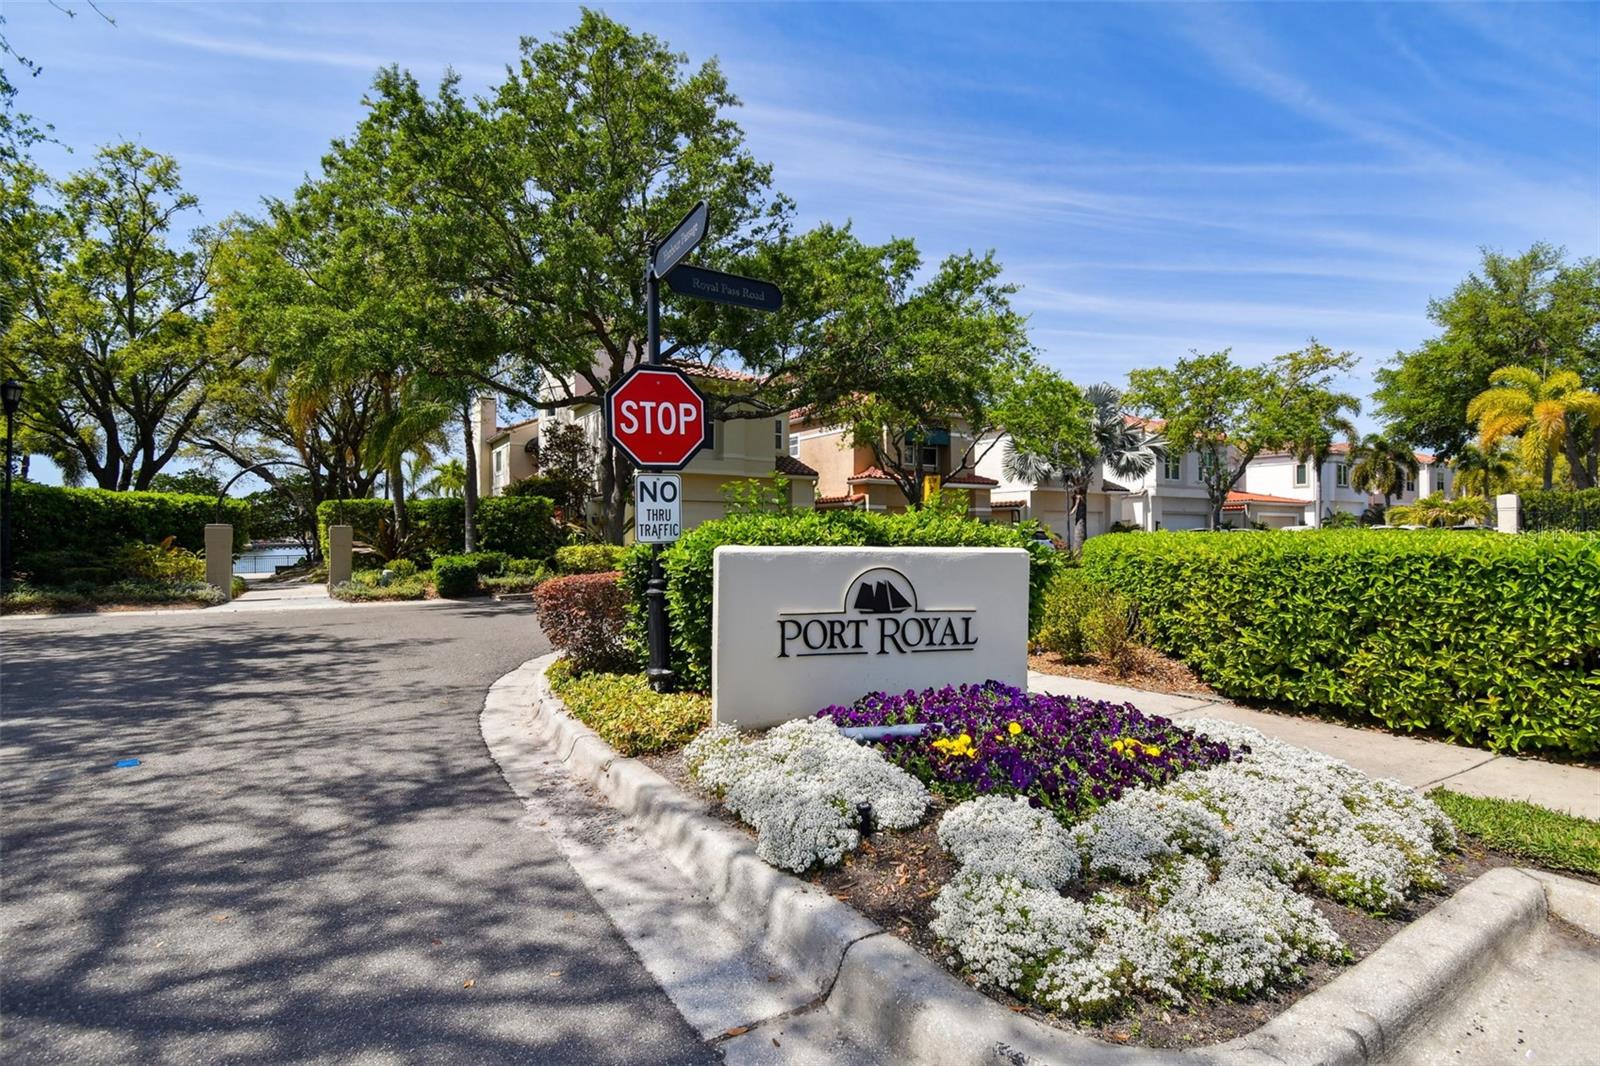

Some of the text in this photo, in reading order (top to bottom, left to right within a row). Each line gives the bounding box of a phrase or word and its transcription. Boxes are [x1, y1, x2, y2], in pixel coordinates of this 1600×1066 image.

[692, 277, 766, 301] Royal Pass Road
[619, 399, 697, 435] STOP
[639, 480, 677, 503] NO
[646, 508, 672, 522] THRU
[639, 523, 679, 537] TRAFFIC
[776, 616, 979, 658] PORT ROYAL
